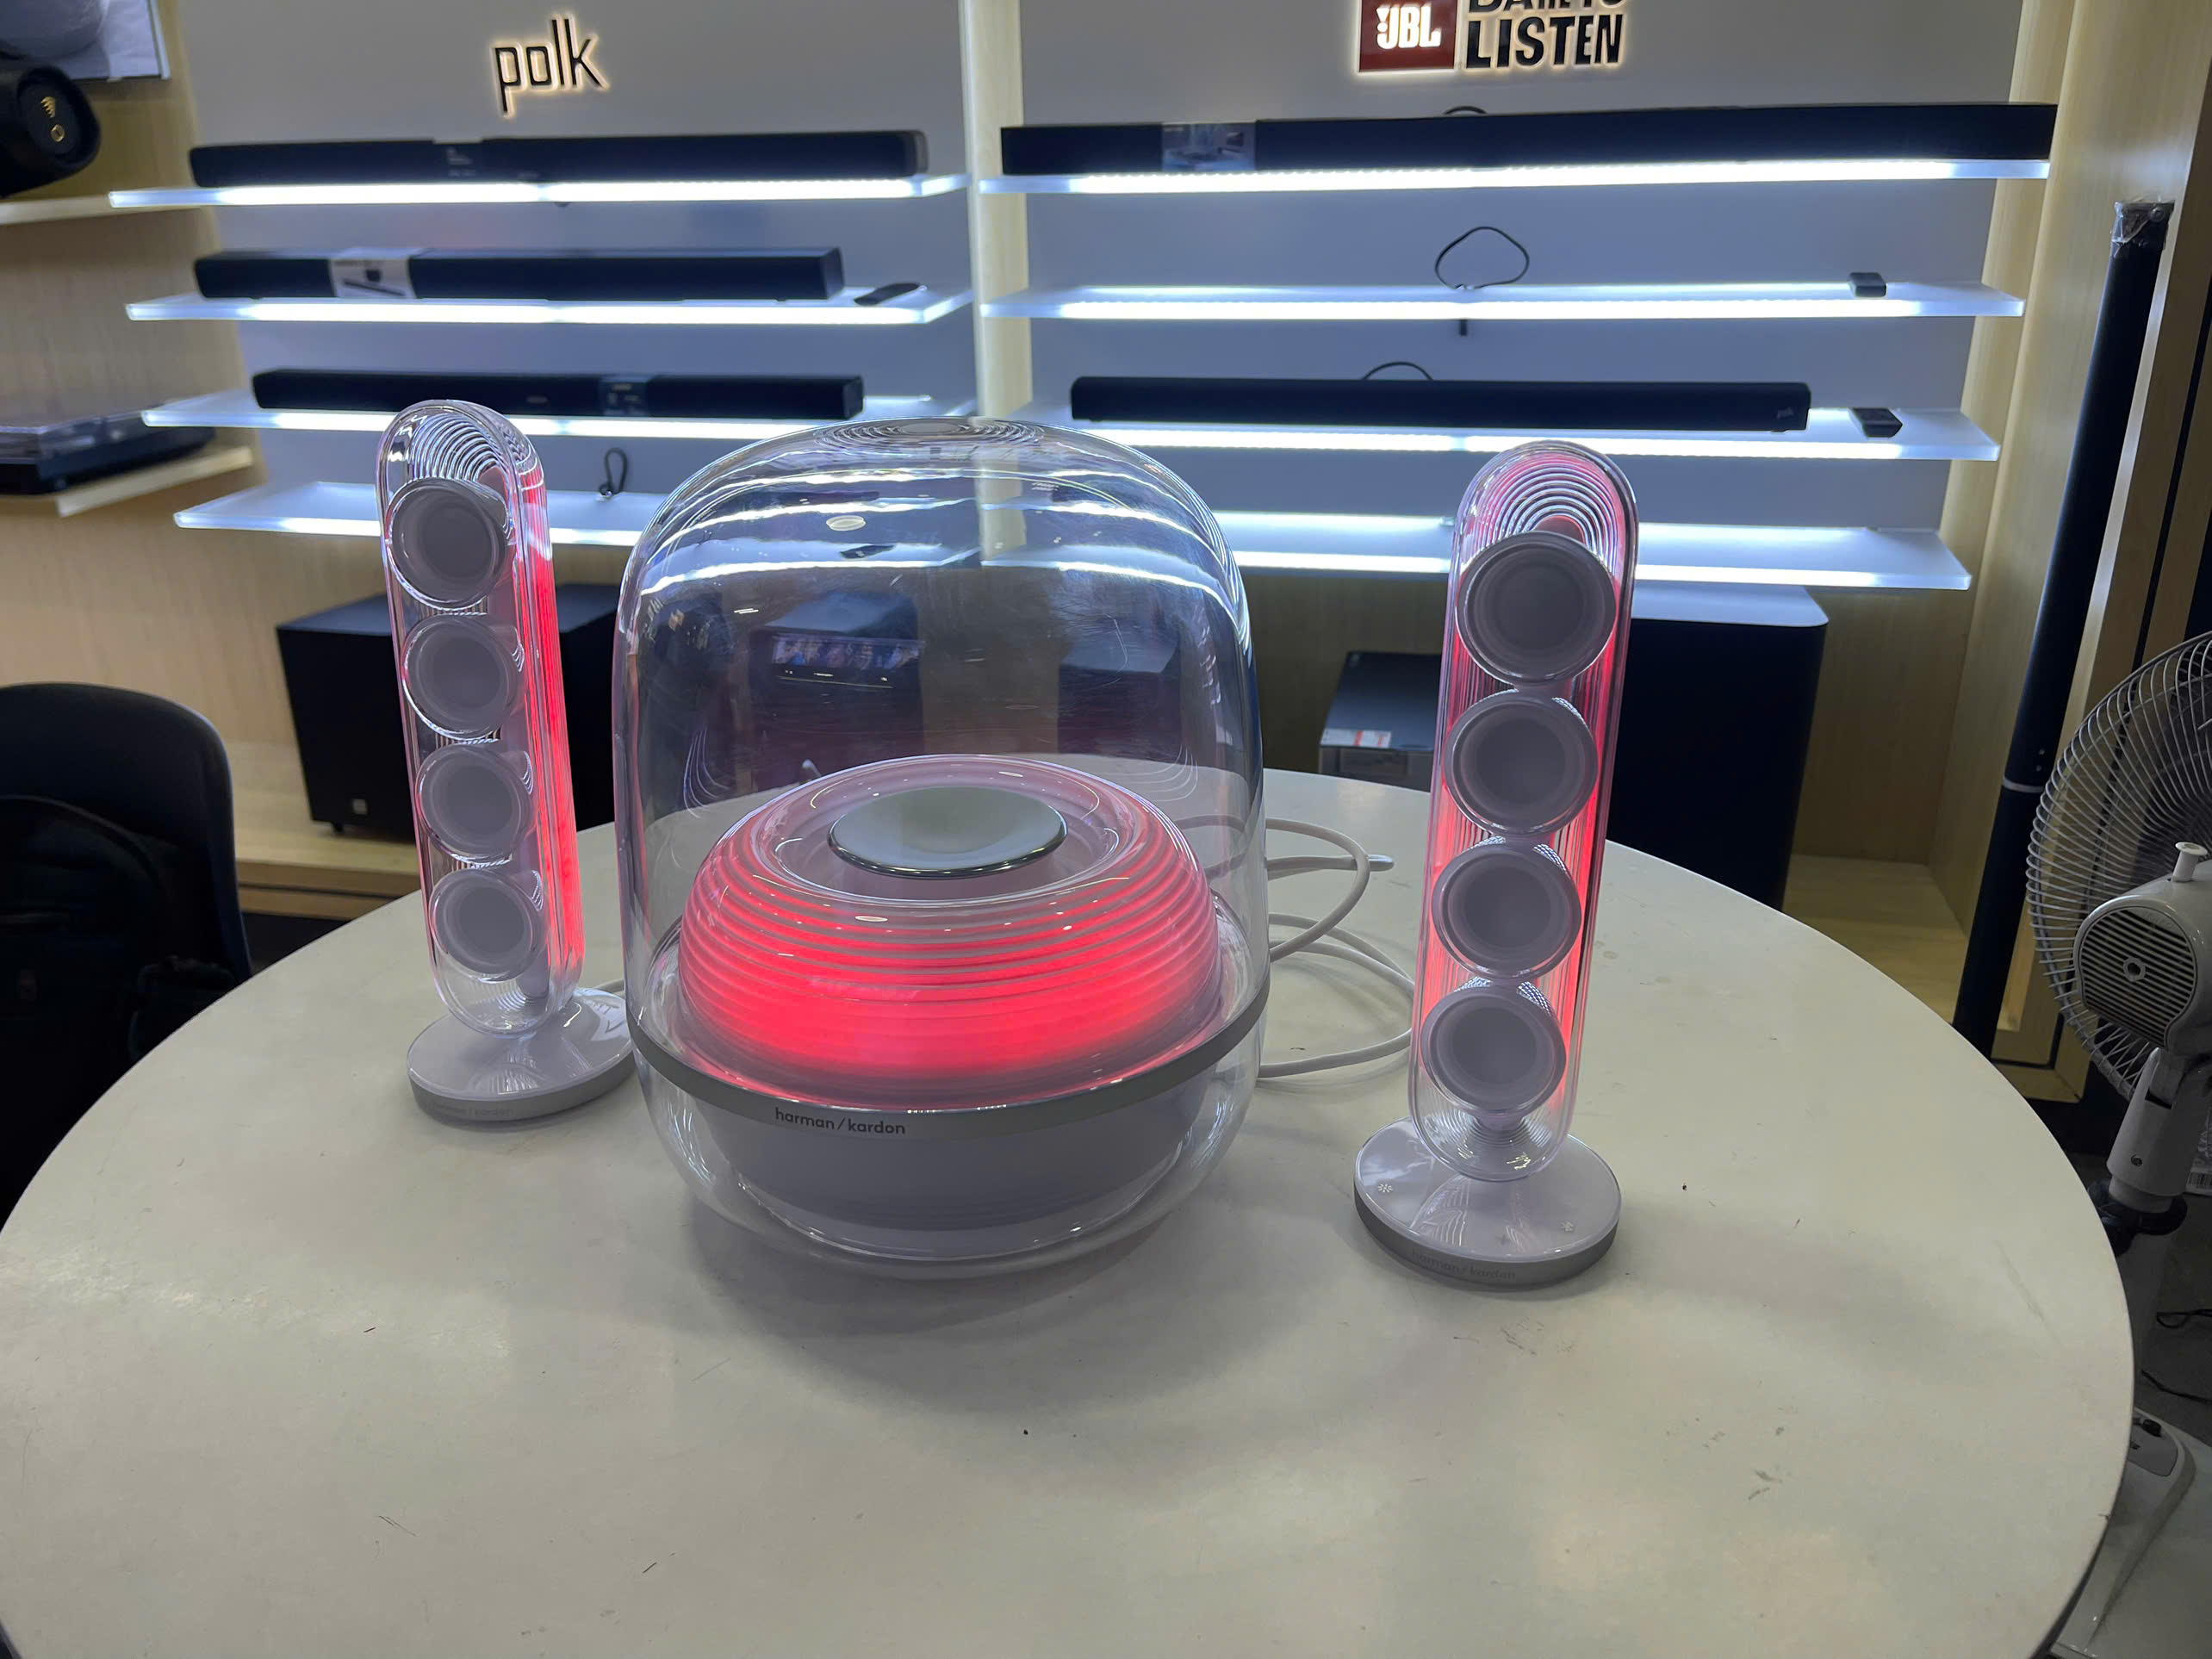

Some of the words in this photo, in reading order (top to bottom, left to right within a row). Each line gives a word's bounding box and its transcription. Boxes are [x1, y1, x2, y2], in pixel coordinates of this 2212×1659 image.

[1376, 4, 1441, 50] JBL
[1466, 14, 1623, 68] LISTEN
[494, 18, 604, 115] polk
